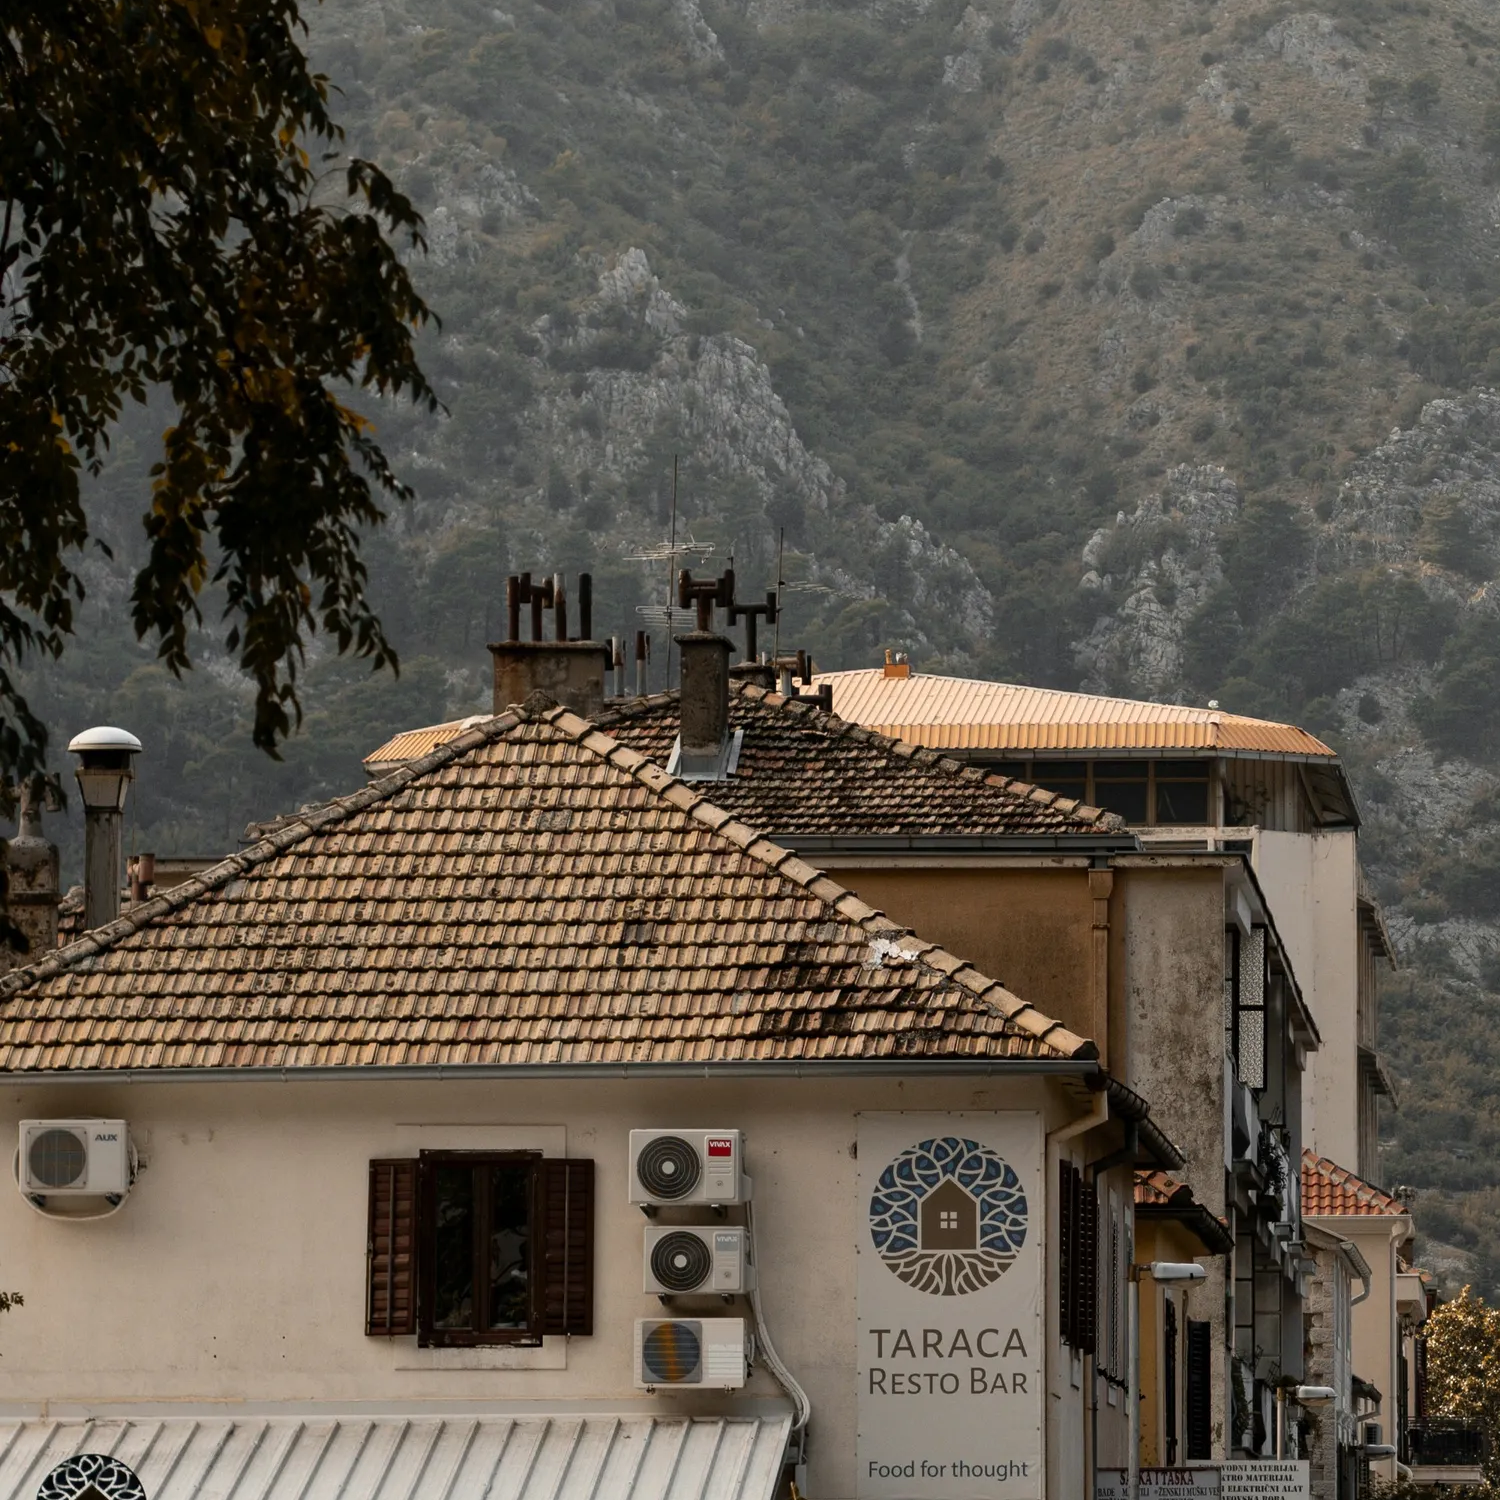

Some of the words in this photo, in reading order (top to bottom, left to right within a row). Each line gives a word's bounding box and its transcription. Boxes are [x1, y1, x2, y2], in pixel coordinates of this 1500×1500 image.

[94, 1133, 118, 1142] AUX
[869, 1328, 1028, 1358] TARACA
[869, 1460, 915, 1478] Food
[920, 1460, 947, 1477] for
[951, 1459, 1028, 1482] thought
[1250, 1464, 1299, 1472] MATERIJAL
[1246, 1474, 1295, 1482] MATERIJAL
[1228, 1484, 1279, 1492] ELEKTRIČNI
[1282, 1485, 1304, 1493] ALAT
